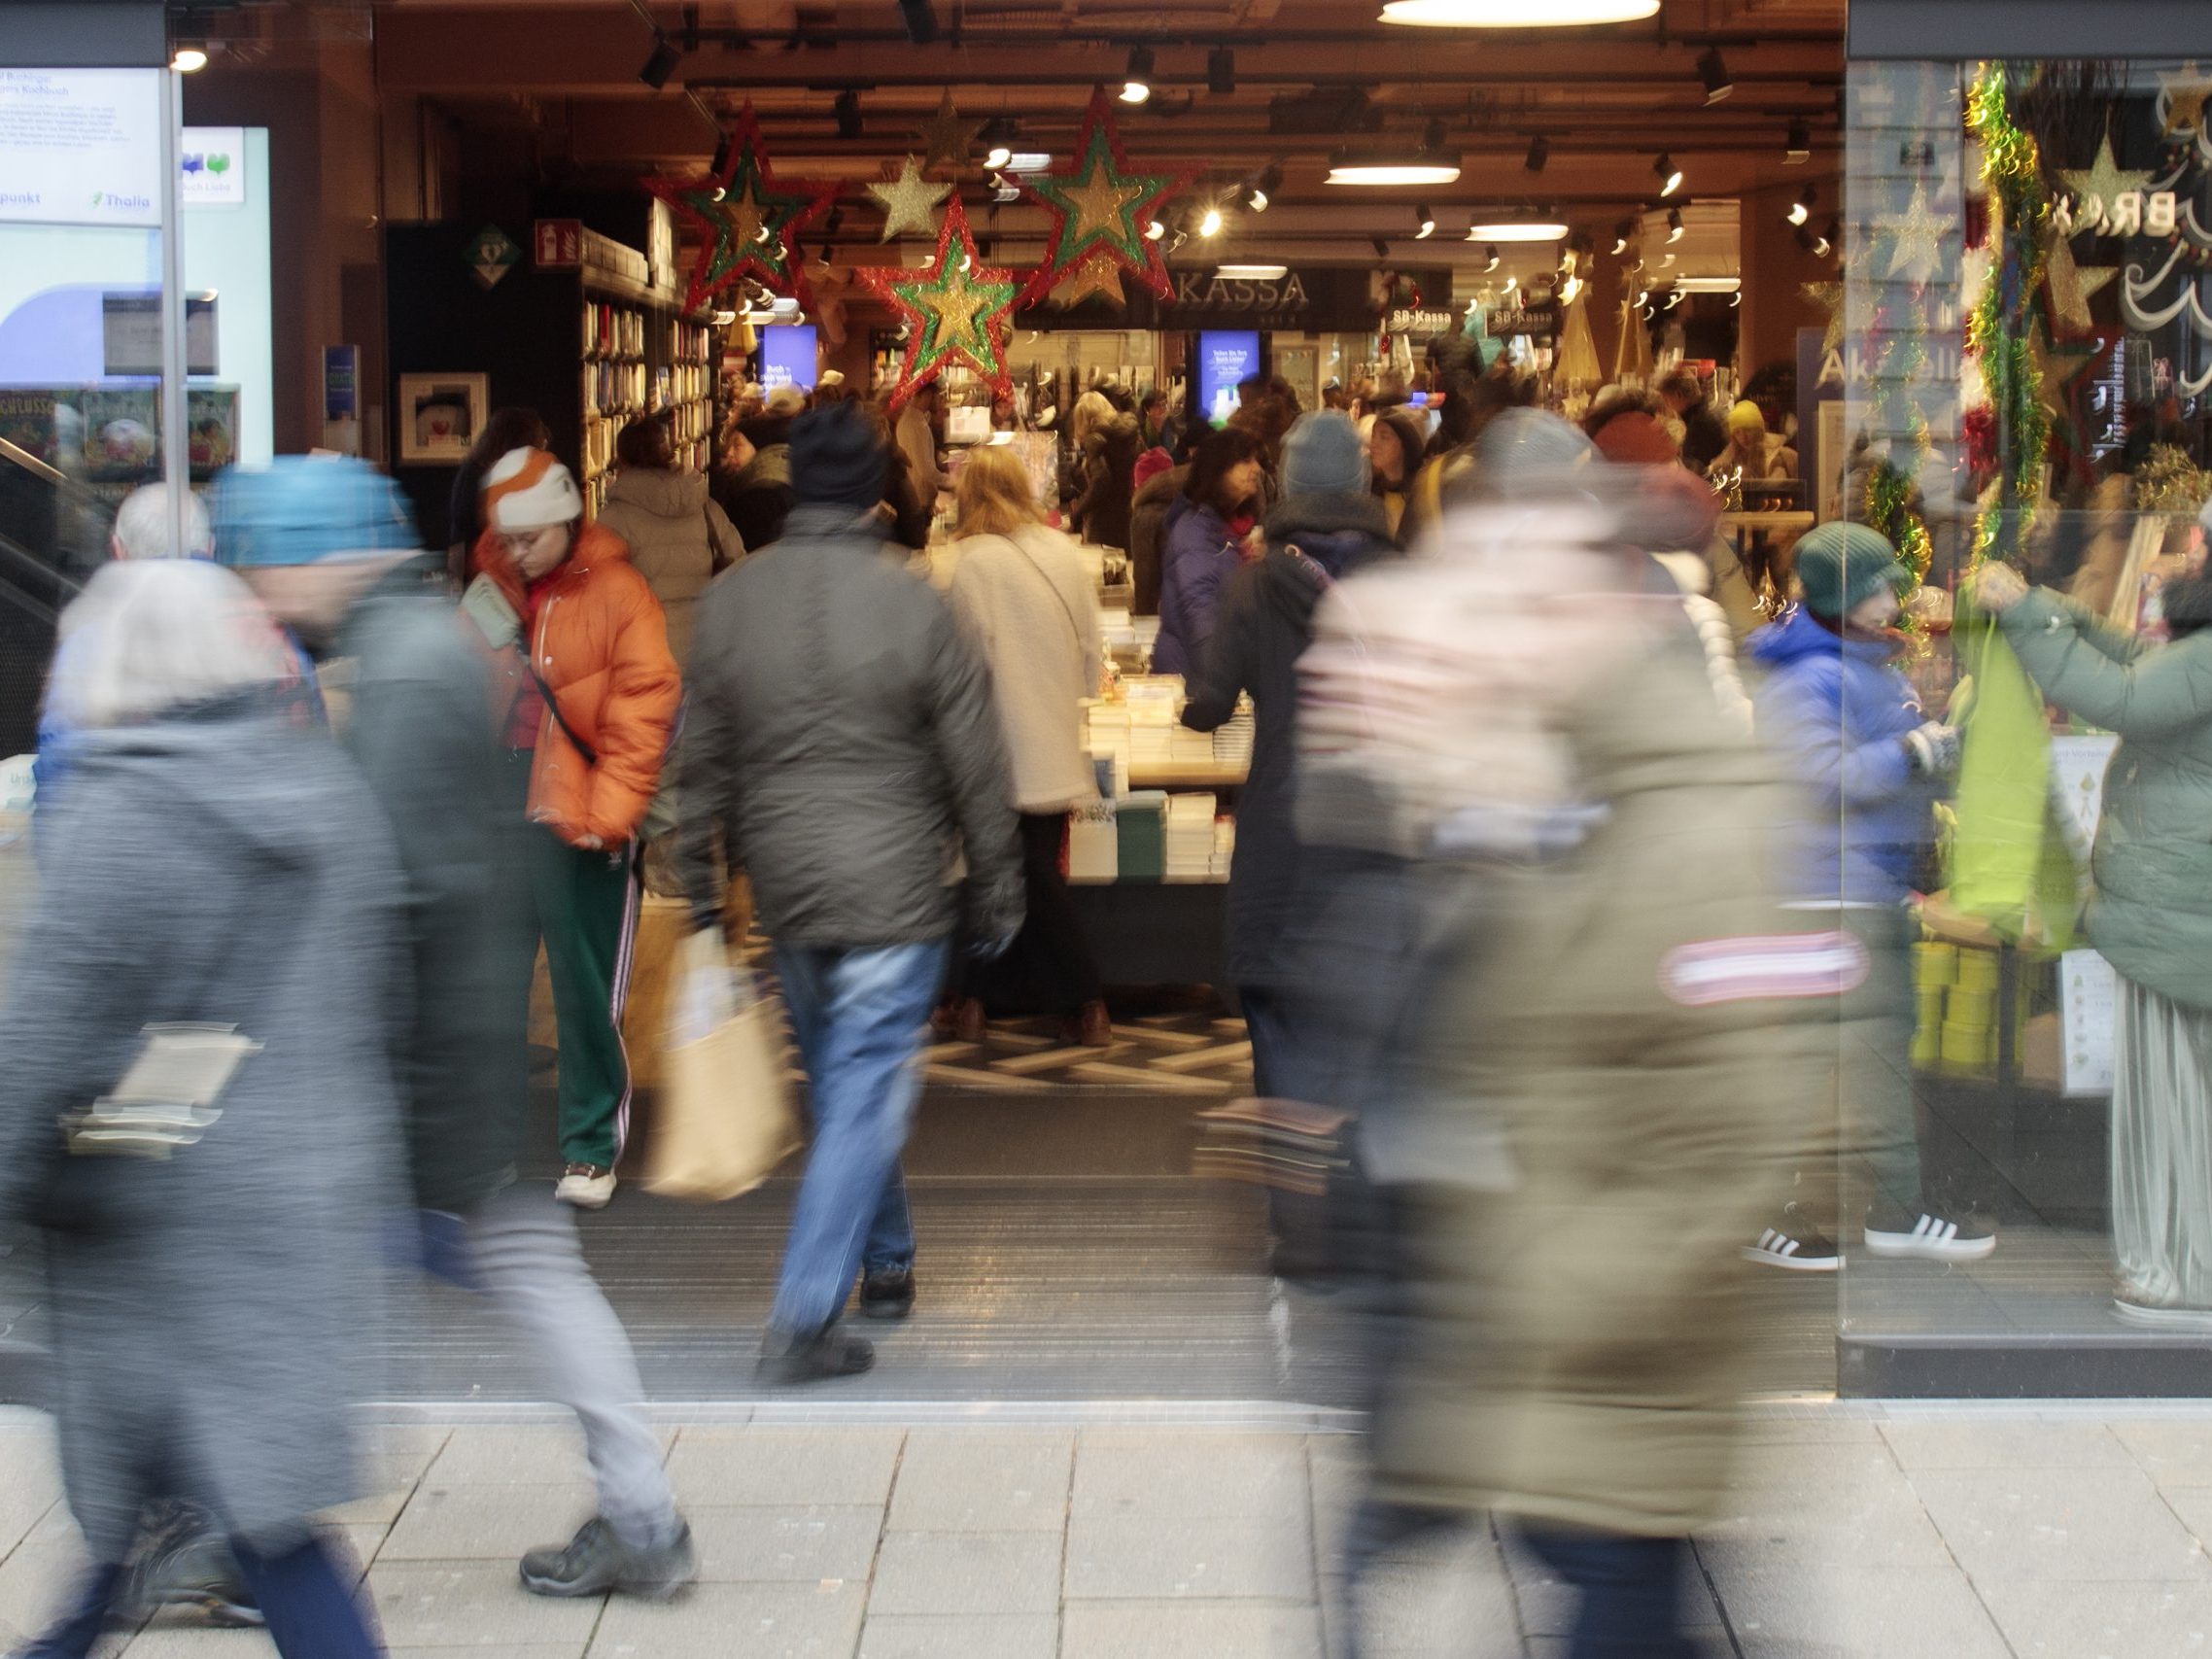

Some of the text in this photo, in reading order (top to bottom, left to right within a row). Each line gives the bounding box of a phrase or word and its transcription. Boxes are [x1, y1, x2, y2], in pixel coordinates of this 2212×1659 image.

[106, 193, 151, 208] Thalia
[1177, 272, 1308, 302] KASSA
[1393, 309, 1452, 324] SB-Kassa
[1494, 309, 1553, 324] SB-Kassa
